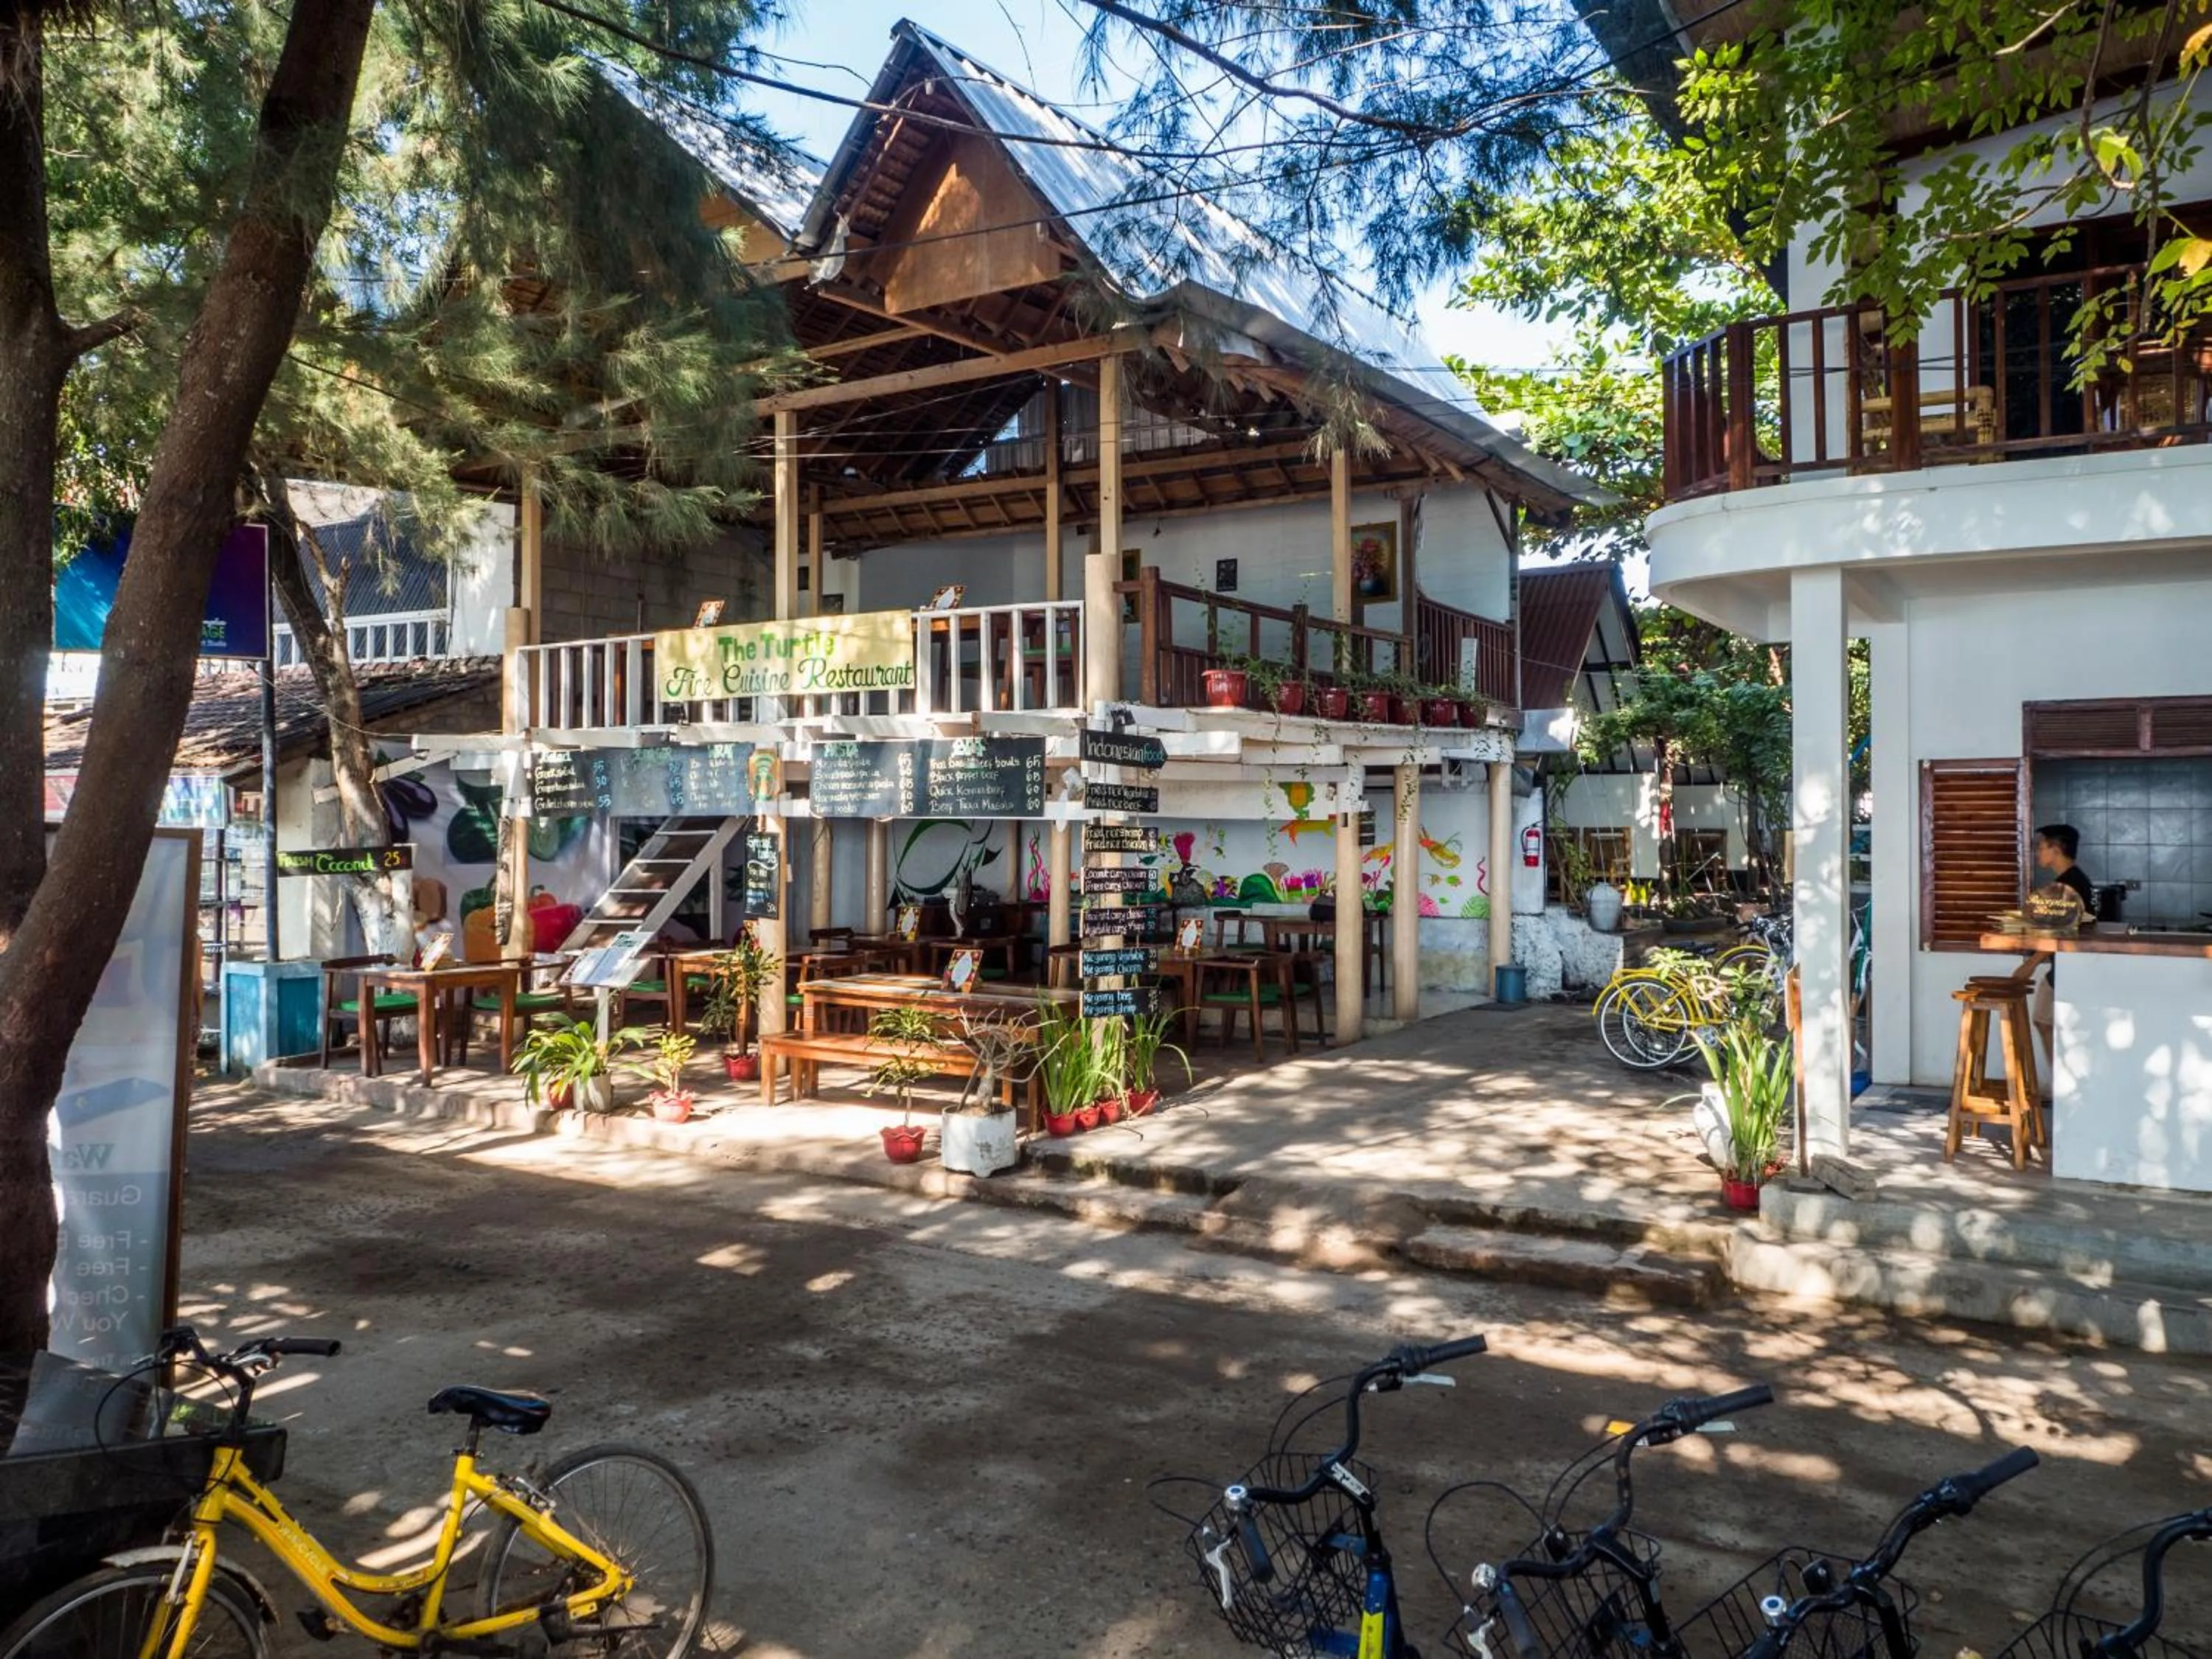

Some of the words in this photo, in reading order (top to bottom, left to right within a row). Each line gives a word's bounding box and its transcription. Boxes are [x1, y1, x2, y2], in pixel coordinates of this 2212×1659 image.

[201, 626, 225, 639] AGE
[718, 636, 757, 661] The
[759, 630, 835, 658] Turtle
[667, 667, 713, 697] Fine
[722, 664, 789, 694] Cuisine
[799, 658, 912, 690] Restaurant
[1086, 734, 1144, 764] Indonesian
[316, 852, 375, 872] Coconut
[384, 851, 400, 867] 25
